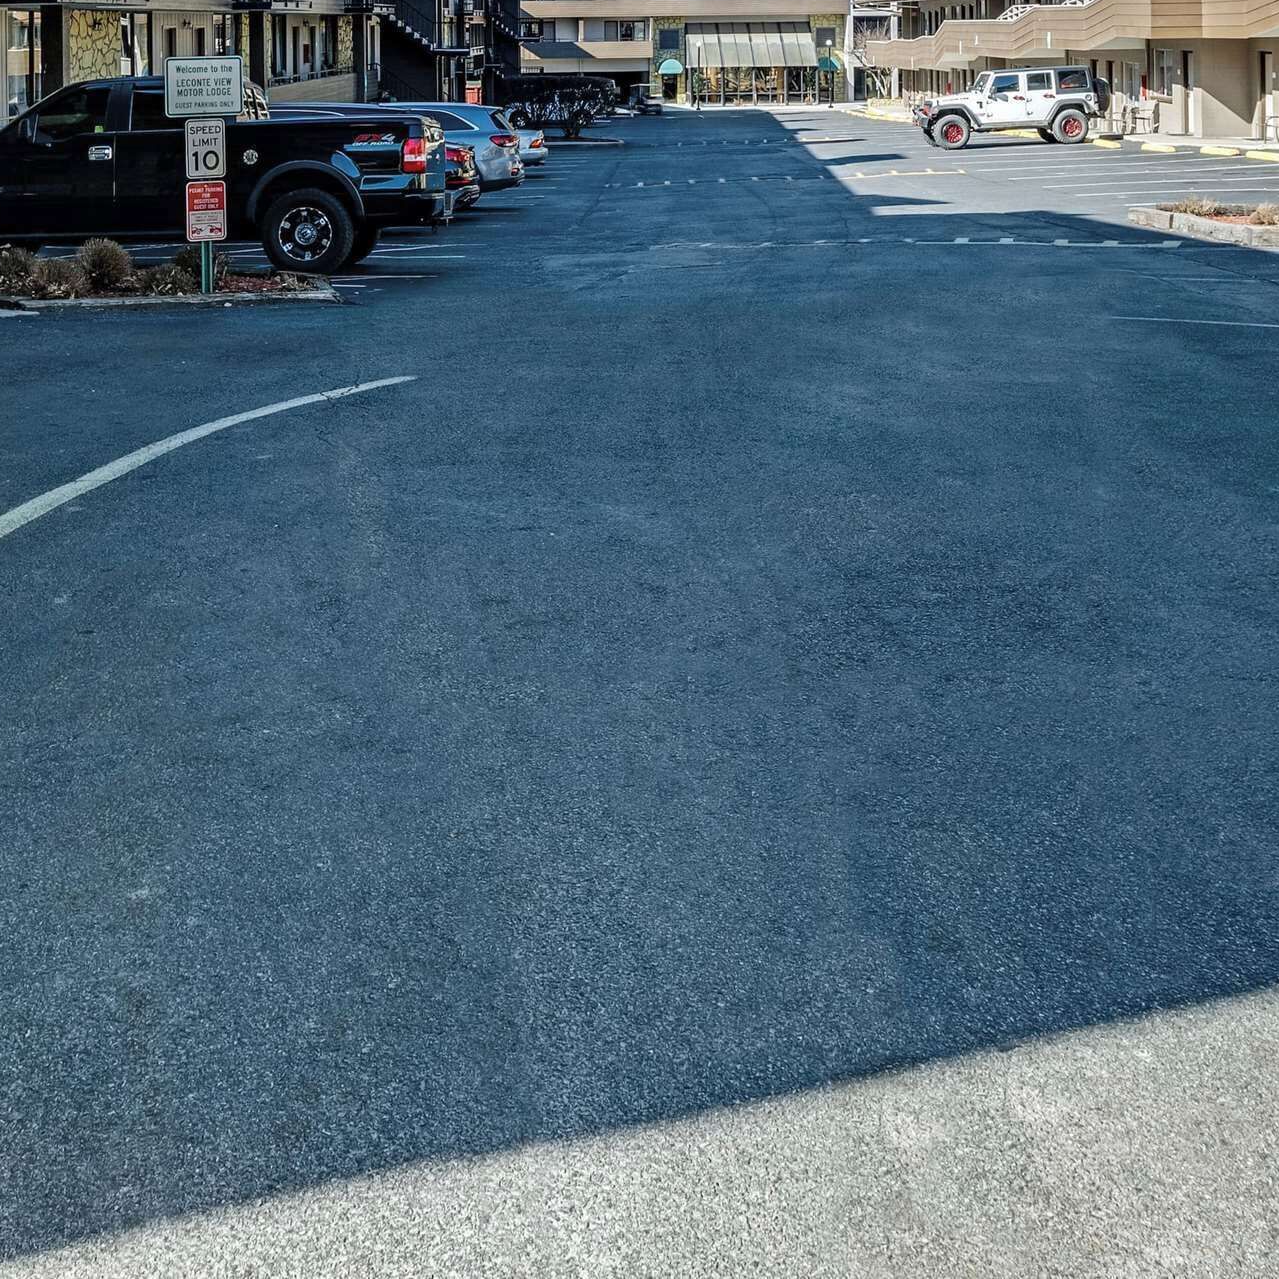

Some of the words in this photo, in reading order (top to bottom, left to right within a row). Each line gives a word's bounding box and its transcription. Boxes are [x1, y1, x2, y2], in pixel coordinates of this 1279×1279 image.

[176, 65, 208, 74] Welcome
[210, 65, 218, 73] to
[221, 64, 233, 73] the
[176, 78, 211, 88] LECONTE
[213, 77, 232, 86] VIEW
[177, 88, 203, 97] MOTOR
[206, 87, 232, 96] LODGE
[175, 101, 192, 109] GUEST
[194, 101, 218, 109] PARKING
[220, 100, 234, 108] ONLY
[190, 125, 222, 135] SPEED
[192, 137, 219, 147] LIMIT
[192, 150, 220, 171] 10
